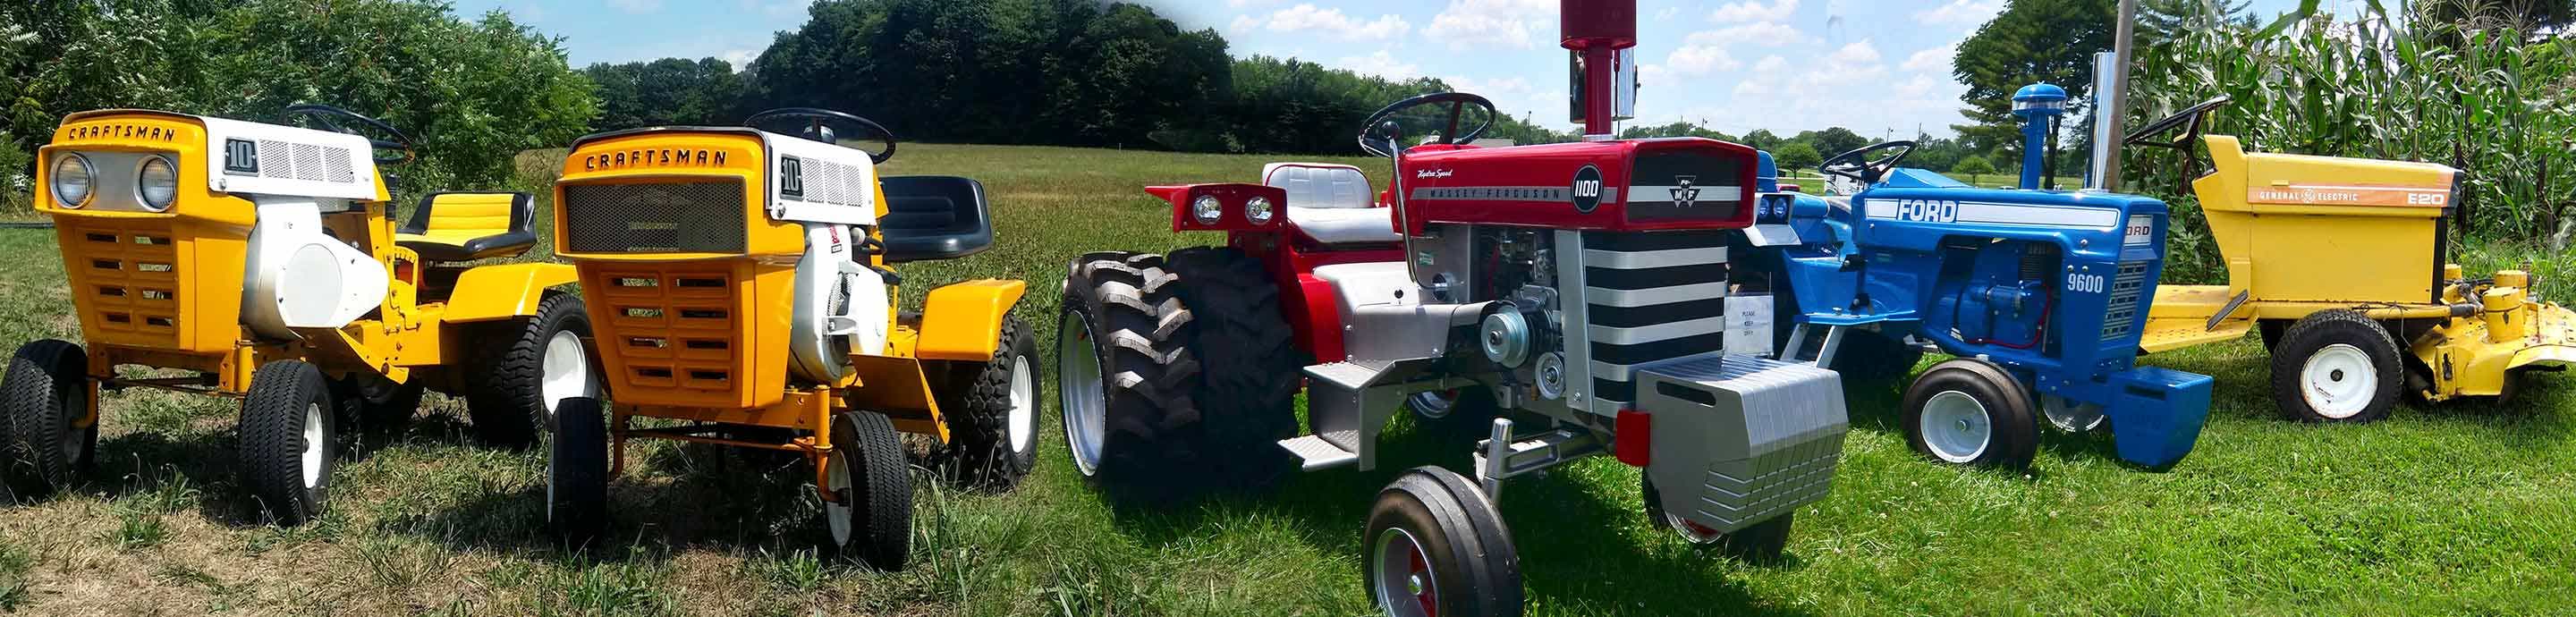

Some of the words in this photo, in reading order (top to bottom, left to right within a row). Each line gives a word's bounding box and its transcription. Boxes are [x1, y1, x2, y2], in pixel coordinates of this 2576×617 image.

[68, 124, 175, 142] CRAFTSMAN
[228, 140, 253, 169] 10
[586, 149, 728, 170] CRAFTSMAN
[782, 158, 800, 191] 10
[1574, 180, 1599, 198] 1100
[2259, 190, 2300, 200] GENERAL
[2318, 192, 2358, 201] ELECTRIC
[2407, 192, 2445, 205] E20
[1897, 199, 1958, 223] FORD
[2125, 225, 2150, 236] ORD
[2067, 273, 2104, 293] 9600
